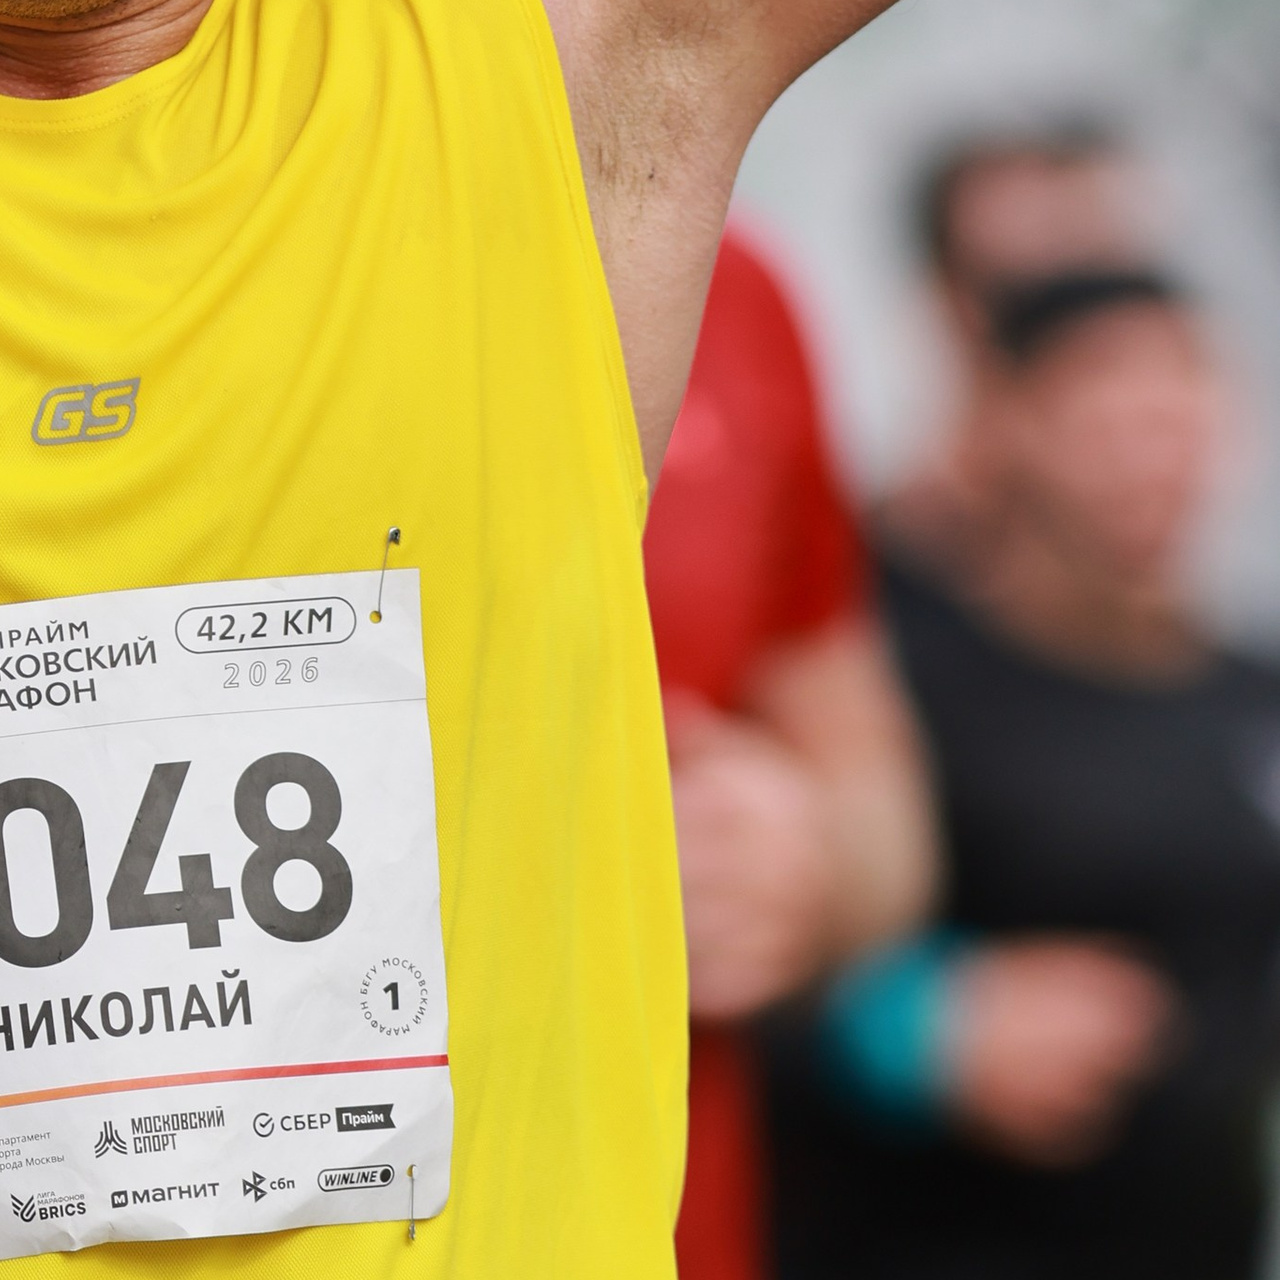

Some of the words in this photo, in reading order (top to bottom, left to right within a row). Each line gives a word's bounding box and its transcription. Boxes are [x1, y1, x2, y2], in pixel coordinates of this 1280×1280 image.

[31, 377, 141, 446] GS
[196, 612, 269, 644] 42,2
[282, 607, 334, 636] КМ
[222, 656, 320, 689] 2026
[360, 965, 378, 995] БЕГУ
[383, 982, 399, 1011] 1
[360, 1001, 411, 1036] МАРАФОН
[130, 1105, 225, 1135] МОСКОВСКИЙ
[280, 1113, 332, 1132] СБЕР
[341, 1110, 384, 1126] Прайм
[133, 1133, 177, 1154] СПОРТ
[25, 1154, 65, 1167] Москвы
[269, 1177, 296, 1190] сбп
[323, 1170, 378, 1187] WINLINE
[36, 1190, 56, 1199] ЛИГА
[37, 1194, 85, 1206] МАРАФОНОВ
[131, 1182, 220, 1205] магнит
[38, 1201, 87, 1221] BRICS
